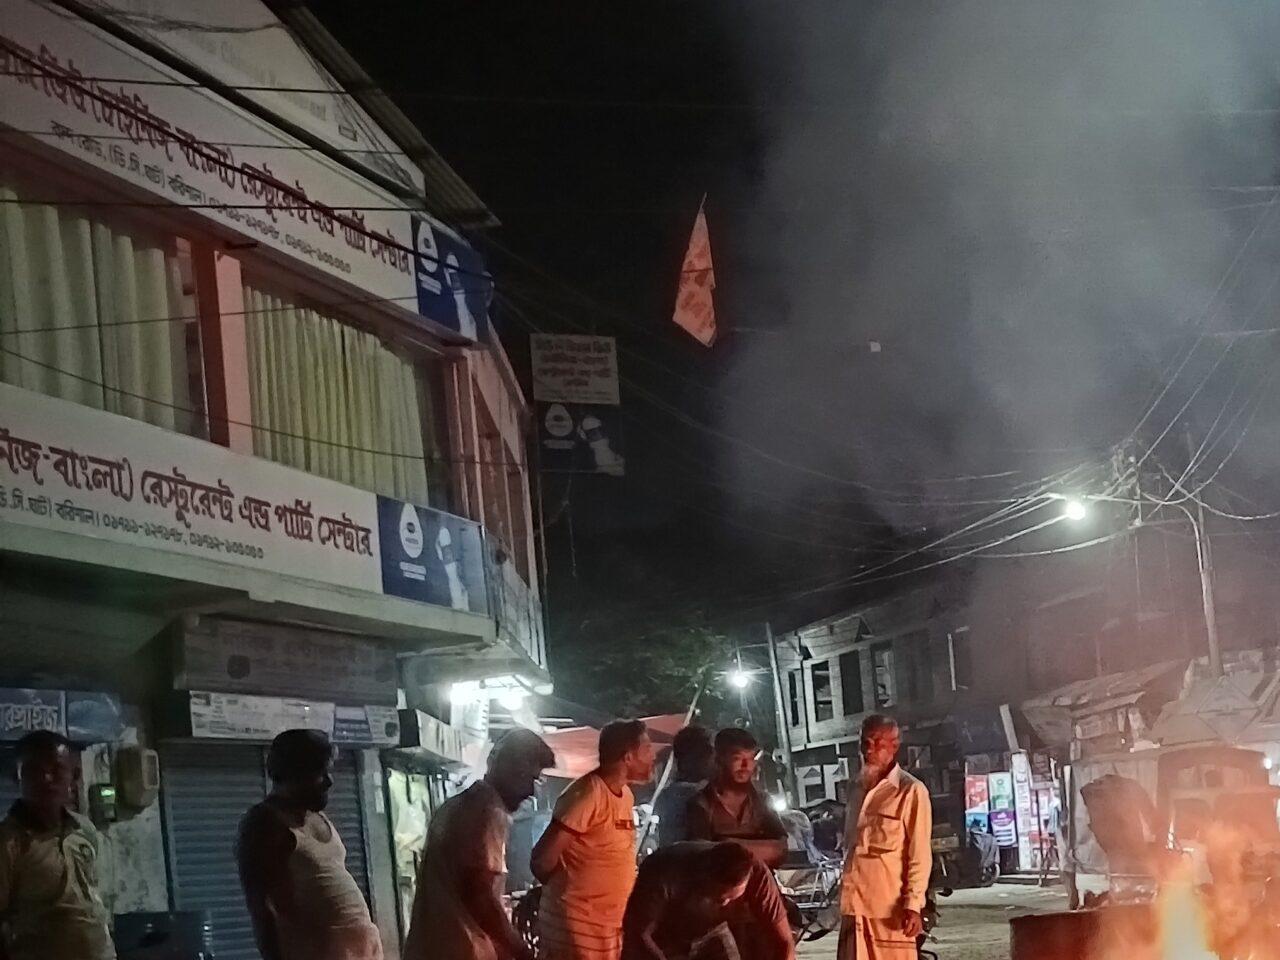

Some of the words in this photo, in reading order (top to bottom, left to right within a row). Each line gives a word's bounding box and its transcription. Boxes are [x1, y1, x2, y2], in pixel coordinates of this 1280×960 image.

[141, 467, 234, 529] রেস্টুরেন্ট
[274, 499, 314, 542] পার্টি
[318, 513, 374, 557] সেন্টার
